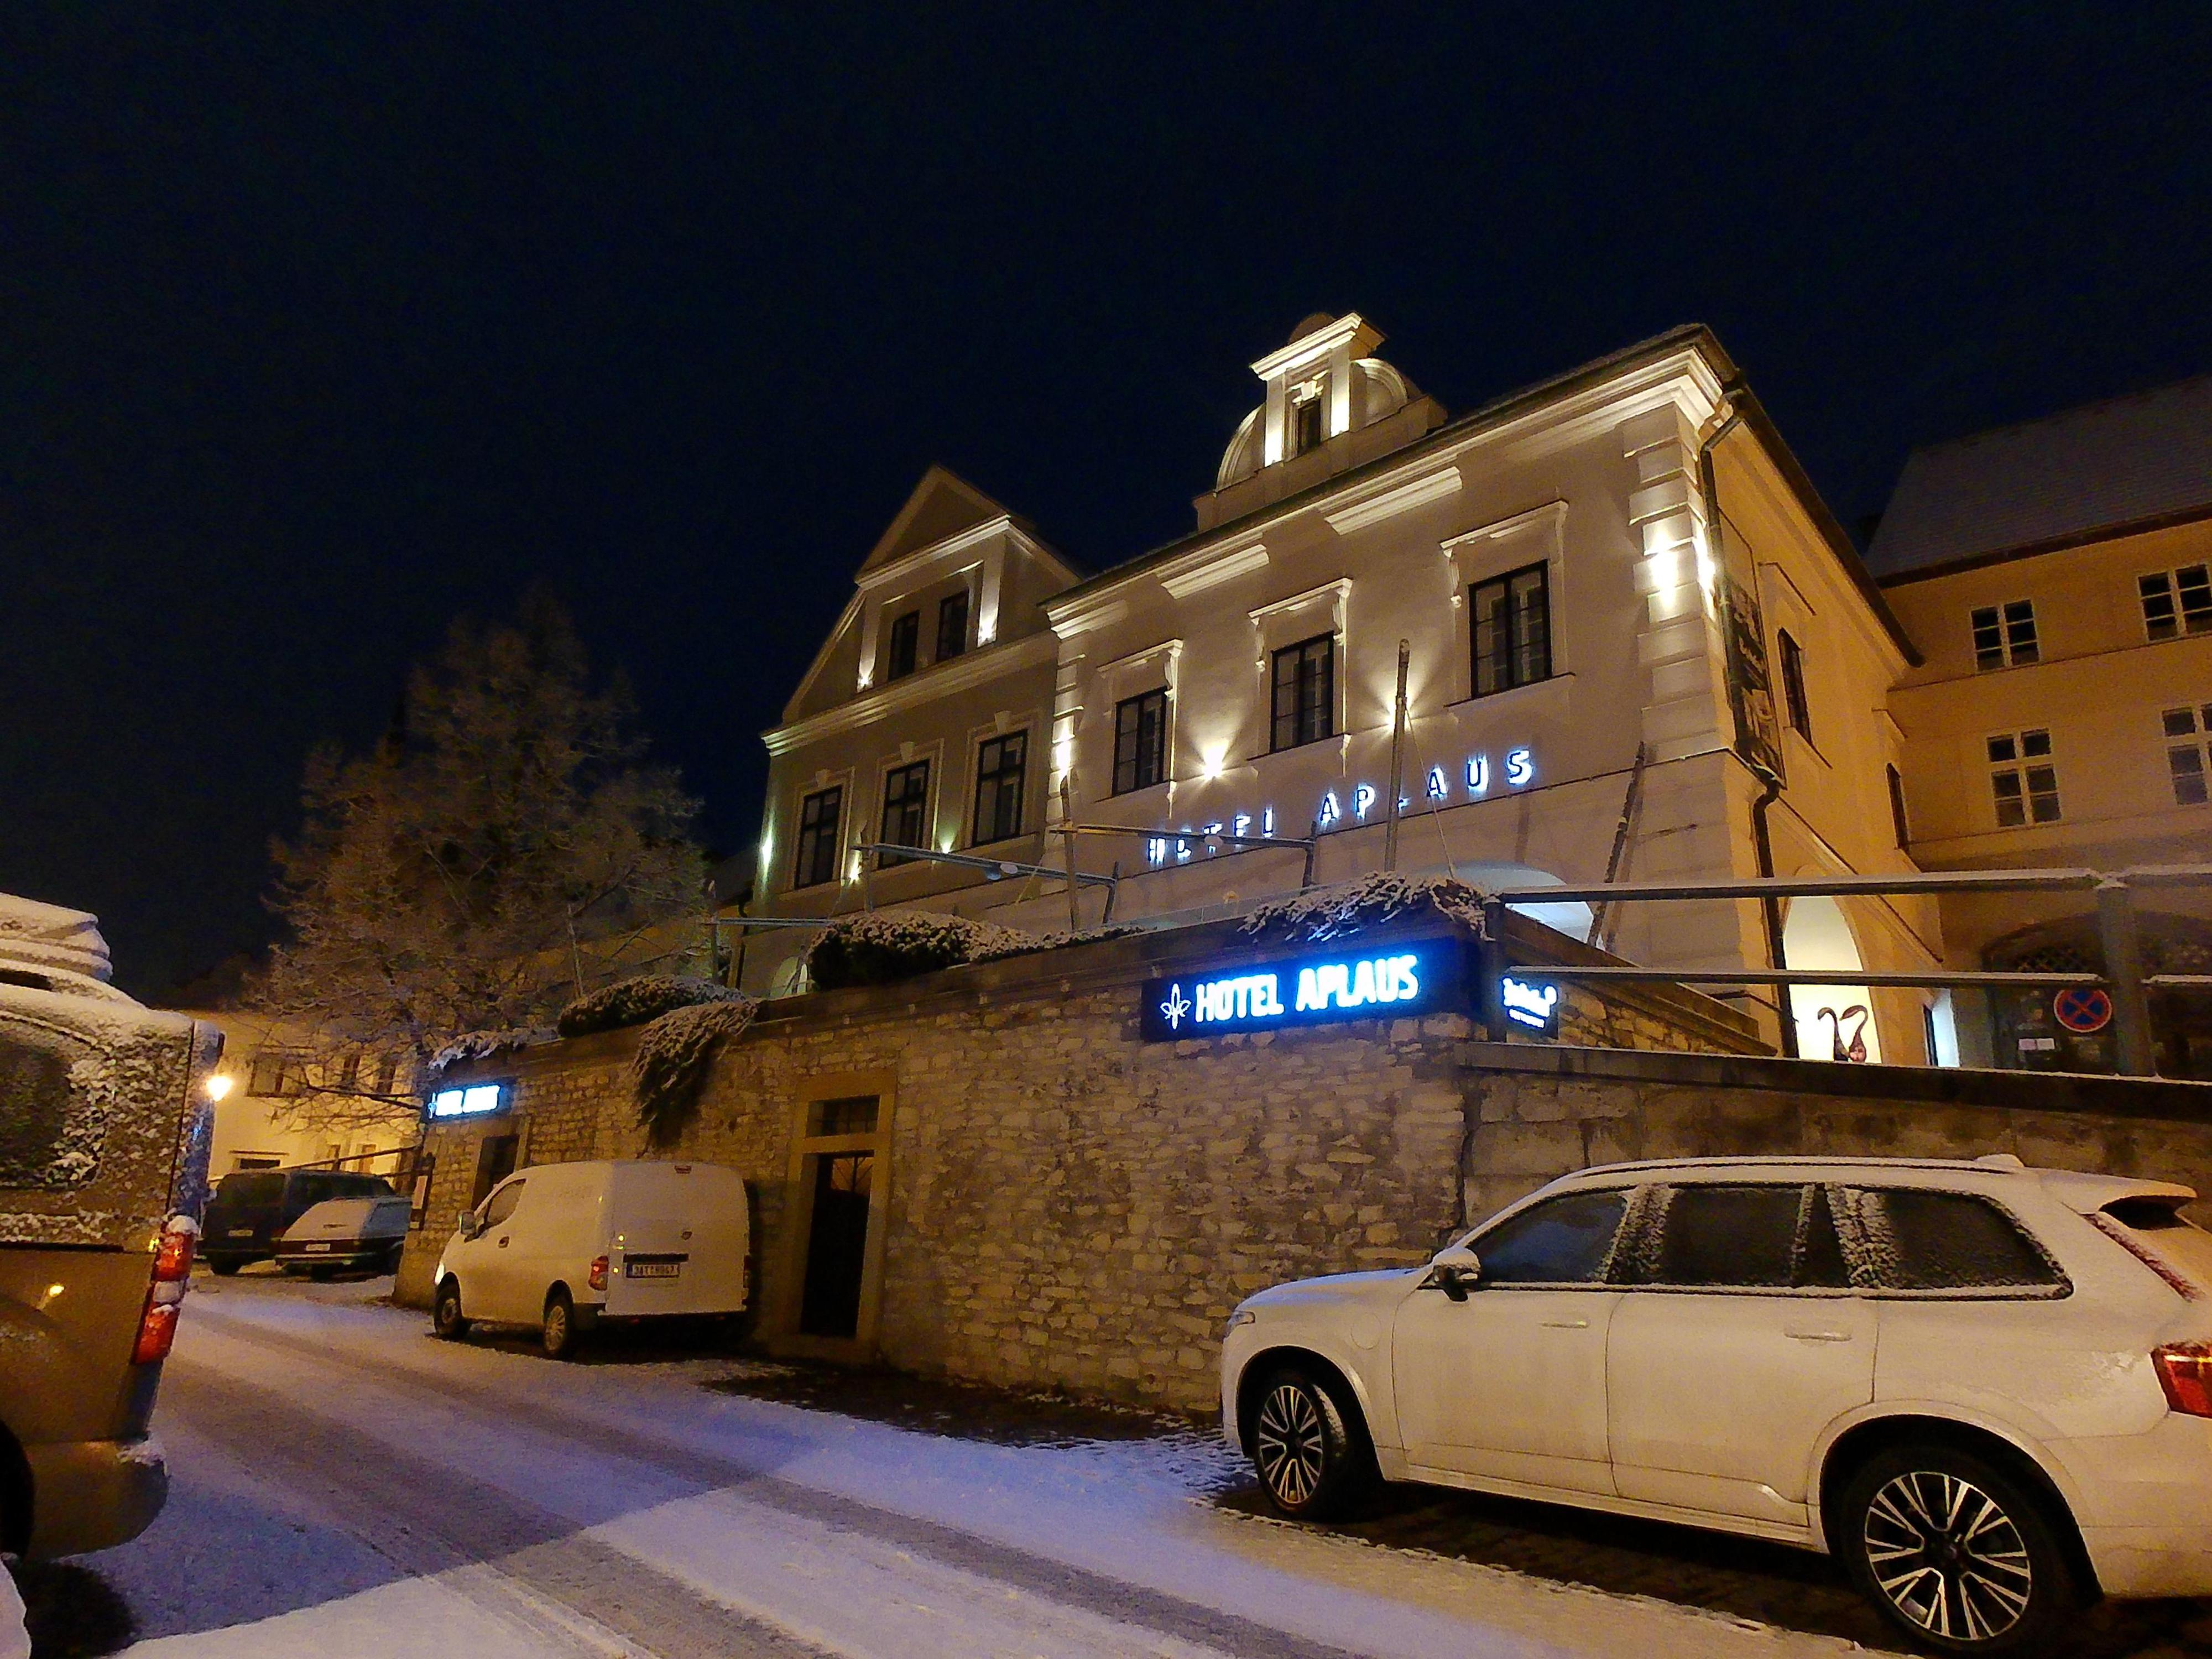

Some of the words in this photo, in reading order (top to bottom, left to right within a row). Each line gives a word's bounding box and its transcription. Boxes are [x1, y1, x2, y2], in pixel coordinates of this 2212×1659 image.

[1320, 749, 1533, 823] APAUS
[1195, 974, 1285, 1022] HOTEL
[1296, 954, 1420, 1011] APLAUS
